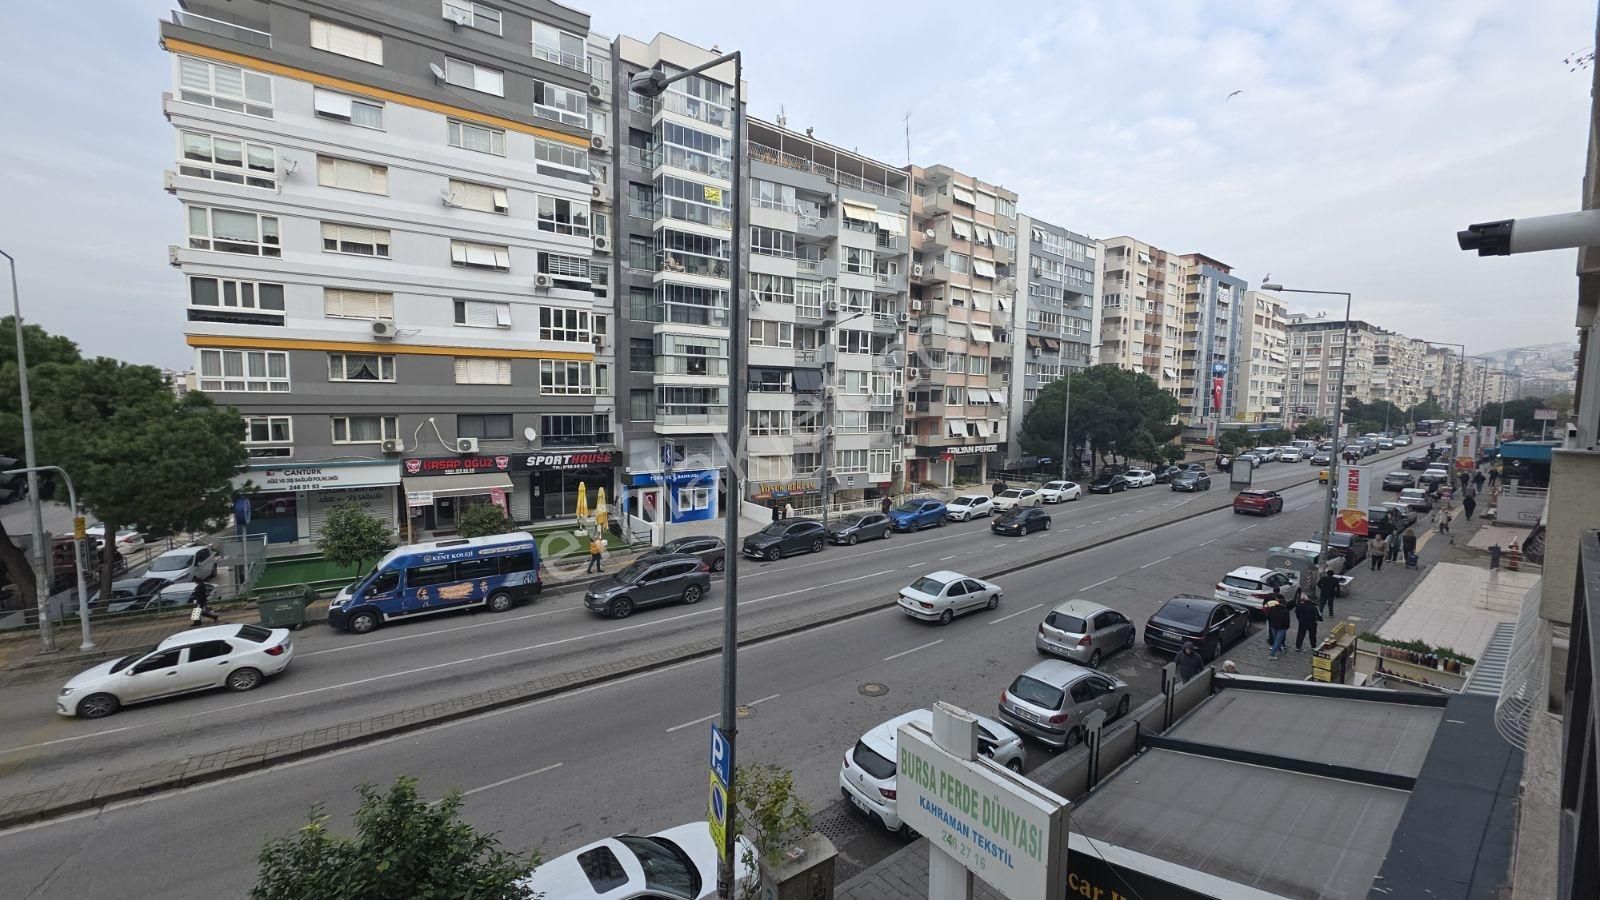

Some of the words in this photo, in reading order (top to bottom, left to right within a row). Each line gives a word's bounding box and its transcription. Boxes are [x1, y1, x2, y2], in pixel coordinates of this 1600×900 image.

[423, 459, 461, 471] KASAP
[901, 747, 937, 794] BURSA
[940, 770, 979, 821] PERDE
[982, 794, 1043, 863] DÜNYASI
[919, 795, 970, 838] KAHRAMAN
[972, 830, 1014, 869] TEKSTİL
[942, 830, 958, 850] 246
[960, 843, 971, 858] 27
[974, 854, 986, 870] 16
